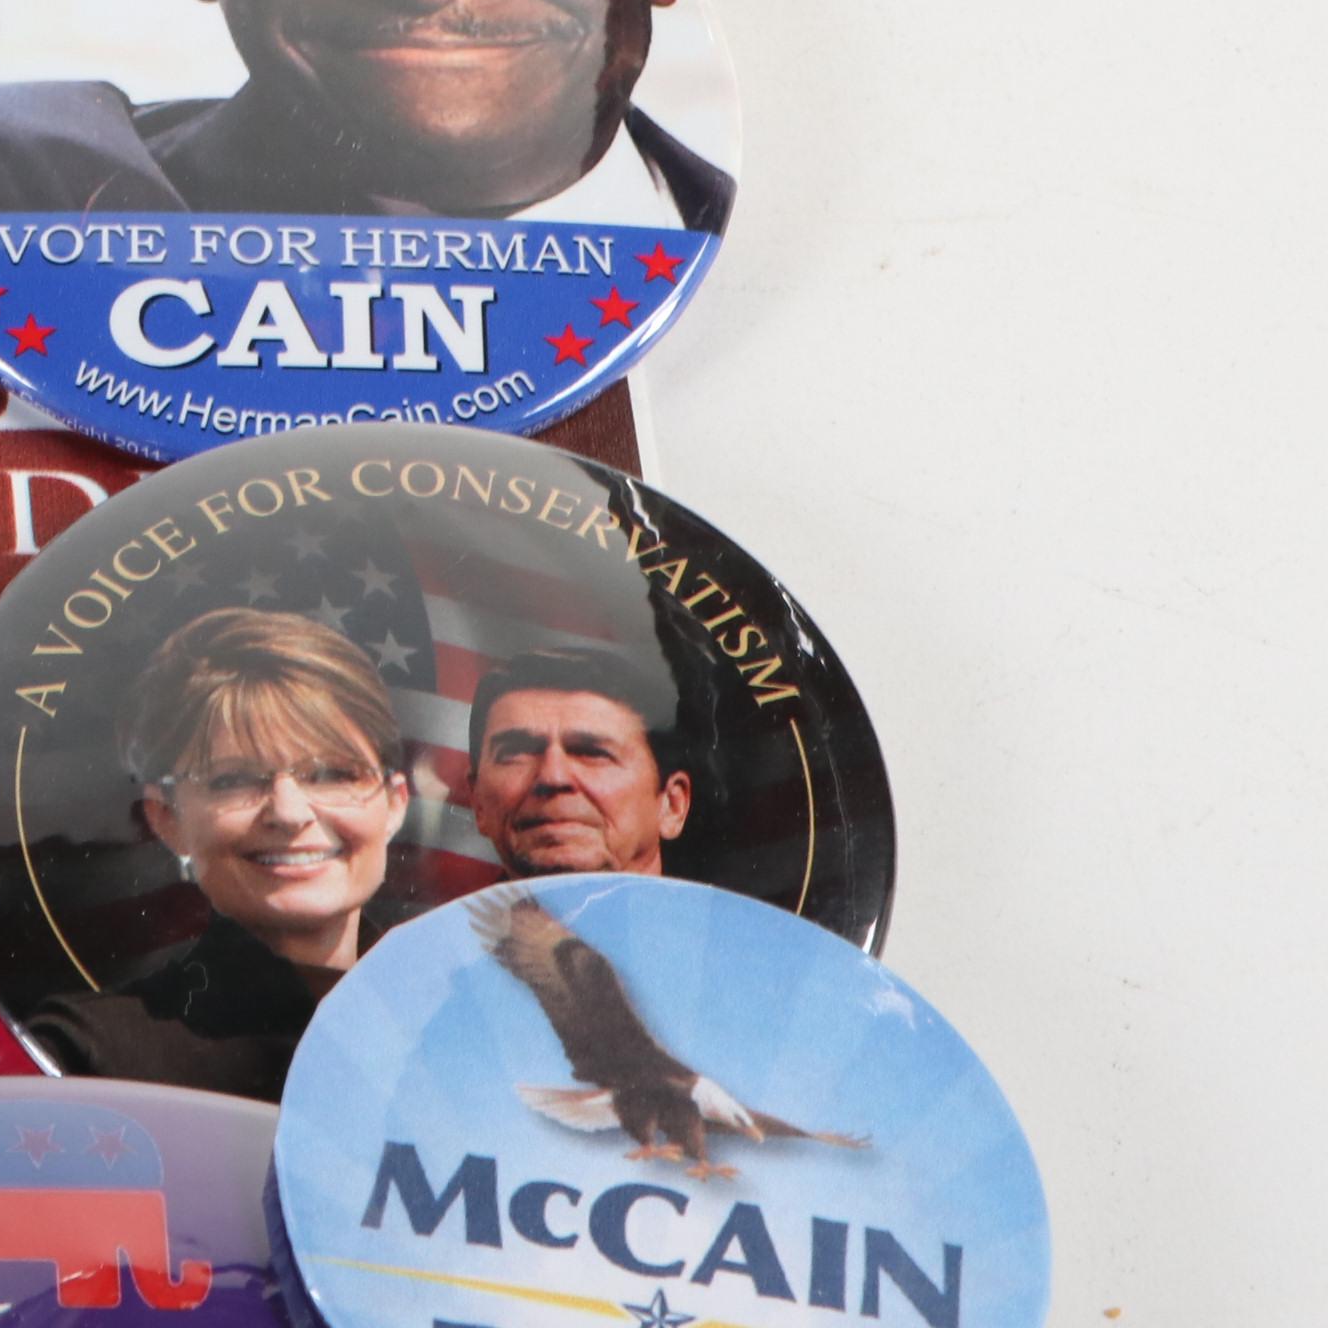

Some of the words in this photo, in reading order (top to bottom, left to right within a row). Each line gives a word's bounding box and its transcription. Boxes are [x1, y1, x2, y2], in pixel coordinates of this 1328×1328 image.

[192, 228, 321, 268] FOR
[341, 230, 615, 277] HERMAN
[109, 278, 497, 373] CAIN
[196, 467, 333, 534] FOR
[31, 517, 197, 656] VOICE
[351, 459, 801, 709] CONSERVATISM
[15, 681, 67, 718] A
[360, 1142, 964, 1328] McCAIN
